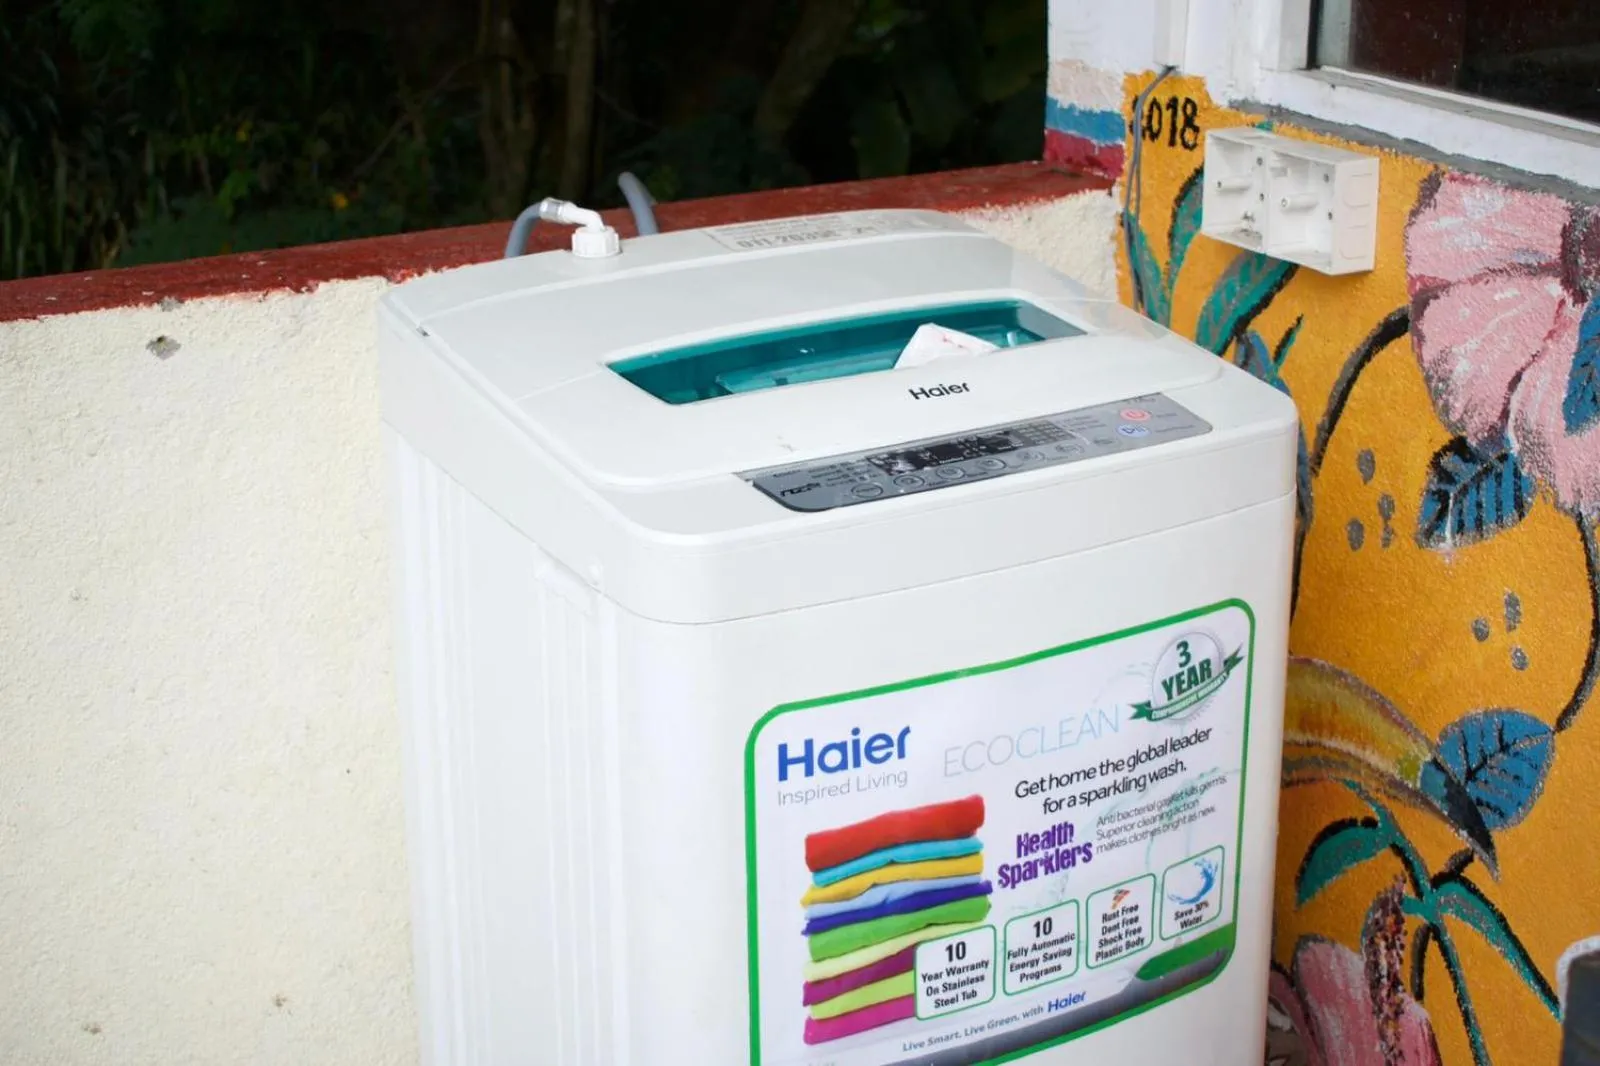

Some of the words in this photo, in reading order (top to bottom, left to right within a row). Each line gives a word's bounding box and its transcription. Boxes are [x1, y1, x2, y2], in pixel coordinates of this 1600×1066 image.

[909, 382, 970, 401] Haier
[1176, 640, 1192, 668] 3
[1161, 658, 1212, 701] YEAR
[777, 725, 911, 782] Haier
[944, 704, 1120, 778] ECOCLEAN
[1015, 777, 1047, 799] Get
[1049, 766, 1096, 791] home
[1099, 758, 1125, 777] the
[1126, 738, 1169, 773] global
[1169, 727, 1213, 754] leader
[778, 779, 850, 806] Inspired
[856, 769, 908, 793] Living
[1043, 797, 1065, 815] for
[1066, 795, 1077, 808] a
[1079, 772, 1147, 807] sparkling
[1149, 758, 1187, 784] wash.
[1096, 812, 1116, 828] Anti
[1096, 821, 1136, 840] Superior
[1016, 821, 1074, 859] Health
[1096, 837, 1128, 854] makes
[998, 842, 1093, 890] Sparklers
[1102, 909, 1120, 924] Rust
[1121, 904, 1139, 916] Free
[1102, 922, 1120, 936] Dent
[1121, 915, 1139, 928] Free
[1033, 917, 1053, 939] 10
[1098, 932, 1123, 948] Shock
[1125, 926, 1142, 938] Free
[945, 940, 967, 963] 10
[1007, 944, 1029, 960] Fully
[1031, 932, 1076, 953] Automatic
[1095, 944, 1123, 961] Plastic
[1125, 936, 1145, 951] Body
[921, 970, 944, 984] Year
[945, 958, 990, 978] Warranty
[1009, 956, 1040, 973] Energy
[1042, 946, 1073, 963] Saving
[926, 984, 940, 997] On
[941, 974, 986, 993] Stainless
[1019, 963, 1062, 984] Programs
[934, 994, 958, 1009] Steel
[959, 989, 978, 1004] Tub
[902, 1039, 925, 1053] Live
[964, 1023, 986, 1037] Live
[1022, 1006, 1044, 1021] with
[1047, 991, 1087, 1013] Haier
